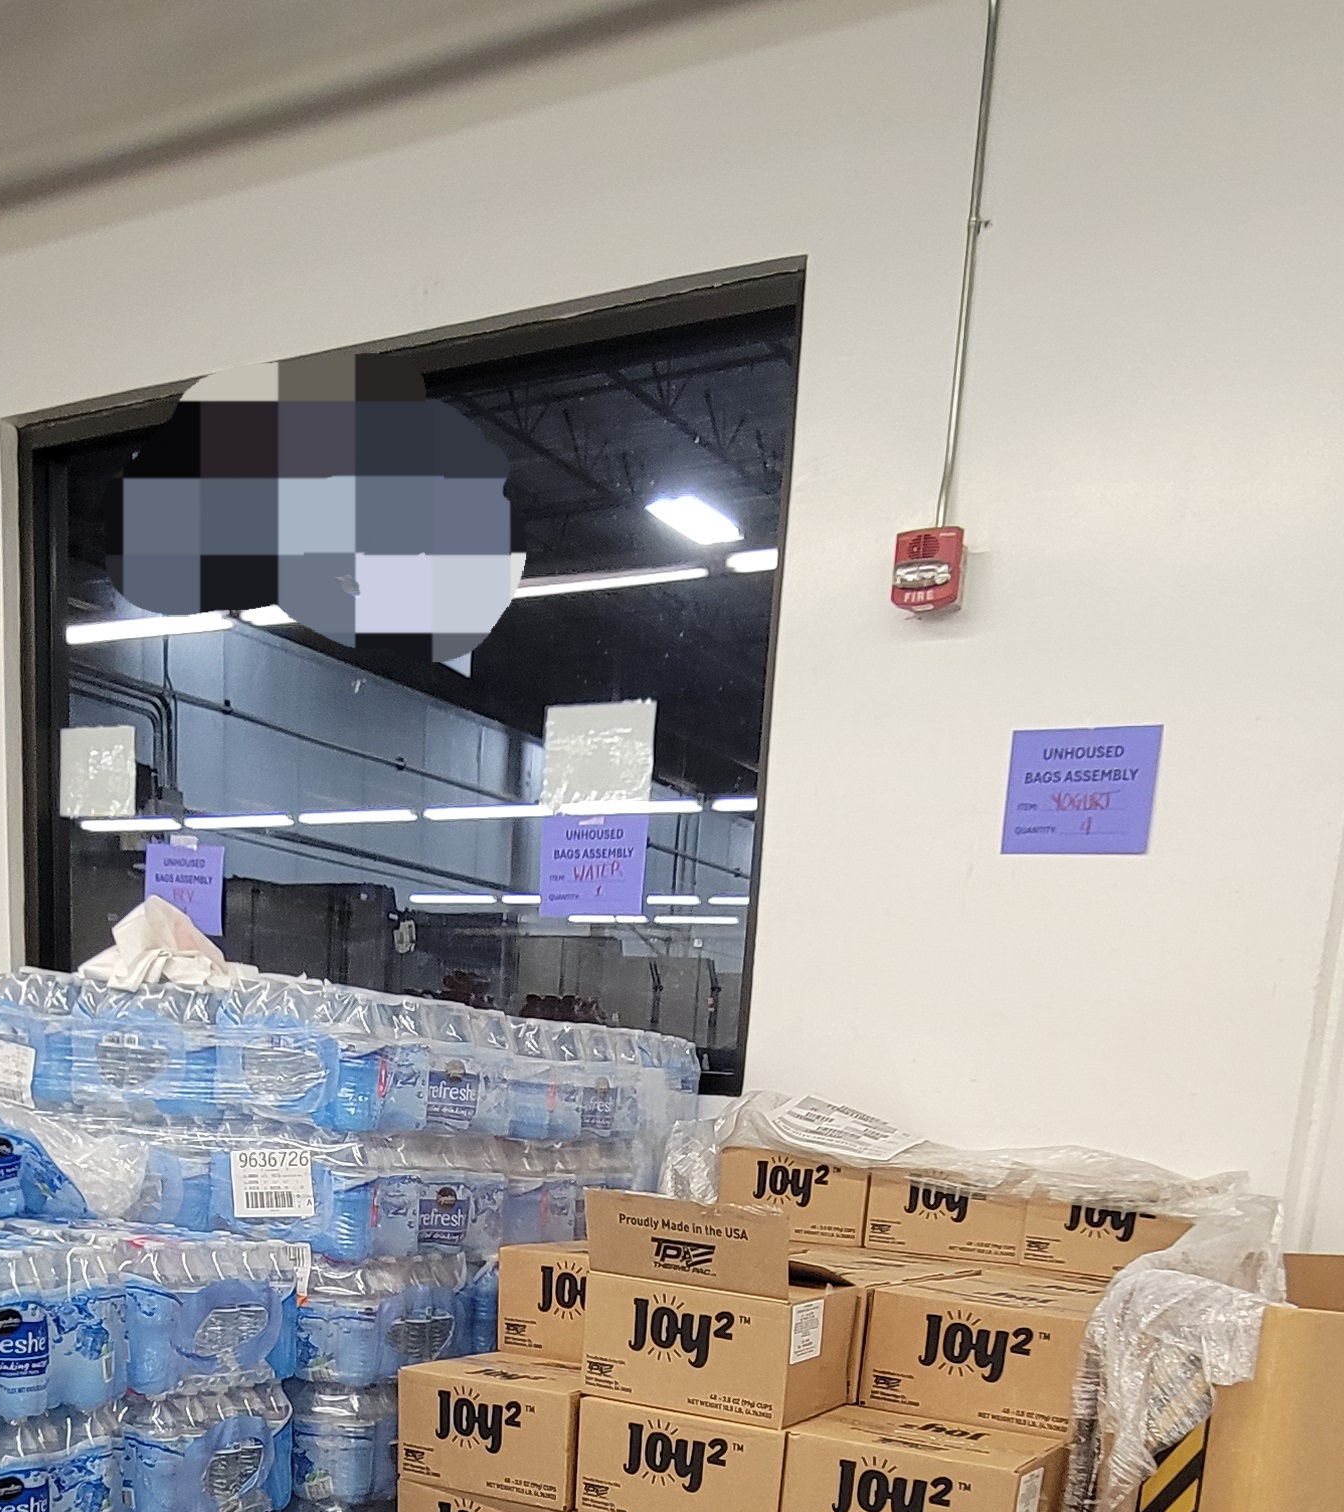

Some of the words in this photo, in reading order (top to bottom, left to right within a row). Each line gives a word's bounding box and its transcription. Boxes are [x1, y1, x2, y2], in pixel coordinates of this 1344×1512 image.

[903, 590, 935, 603] FIRE
[1042, 745, 1125, 760] UNHOUSED
[1024, 771, 1062, 784] BAGS
[1063, 768, 1139, 783] ASSEMBLY
[1051, 789, 1120, 811] YOGURT
[565, 828, 624, 841] UNHOUSED
[553, 849, 581, 860] BAGS
[582, 847, 634, 859] ASSEMBLY
[163, 858, 206, 868] UNHOUSED
[573, 860, 624, 882] WATER
[155, 873, 174, 883] BAGS
[175, 873, 214, 885] ASSEMBLY
[238, 1150, 309, 1168] 9636726
[618, 1213, 659, 1231] Proudly
[661, 1219, 690, 1232] Made
[692, 1222, 702, 1234] in
[704, 1224, 723, 1237] the
[725, 1227, 749, 1241] USA
